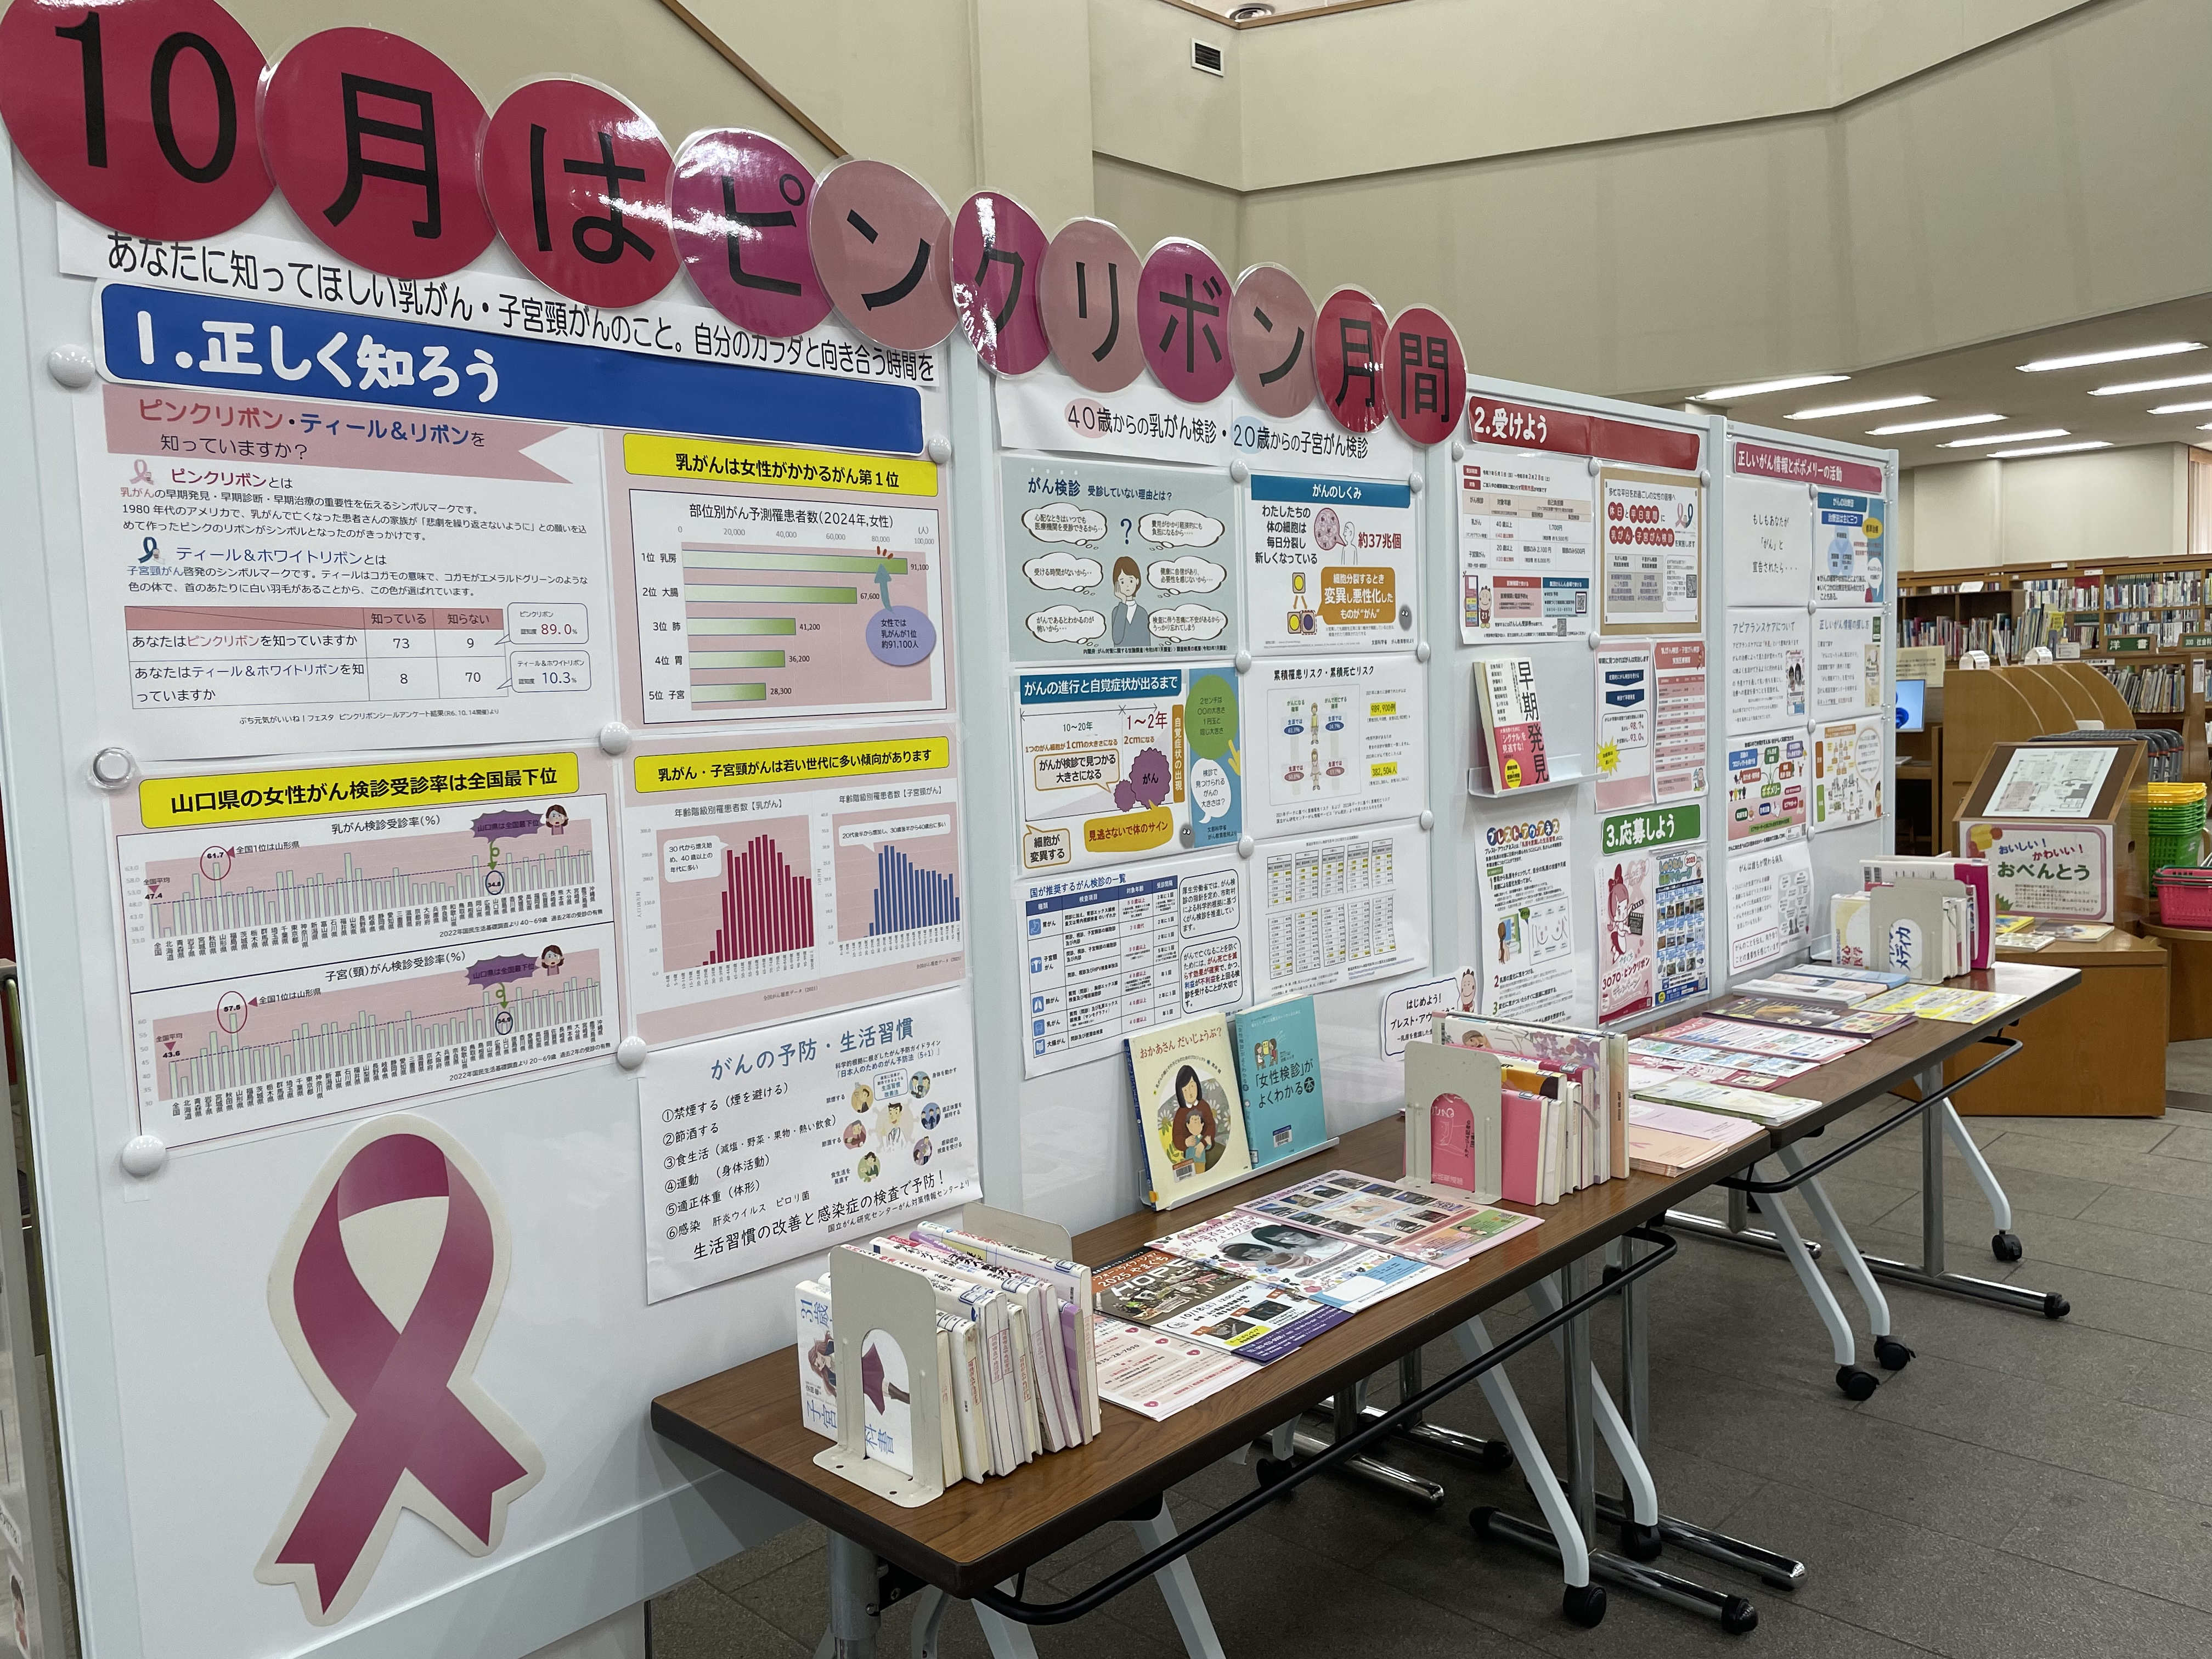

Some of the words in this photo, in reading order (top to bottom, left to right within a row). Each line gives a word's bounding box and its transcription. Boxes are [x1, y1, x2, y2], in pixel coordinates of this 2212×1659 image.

[137, 310, 499, 403] 1.正しく知ろう
[1474, 405, 1548, 443] 2.受けよう
[1067, 404, 1370, 460] 40歳からの乳がん検診・20歳からの子宮がん検診
[161, 433, 308, 460] 知っていますか?
[675, 453, 900, 488] 乳がんは女性がかかるがん第1位
[172, 467, 294, 490] ピンクリボンとは
[1028, 477, 1081, 497] がん検診
[1087, 485, 1172, 501] 受診していない理由とは?
[1312, 483, 1362, 500] がんのしくみ
[1034, 513, 1087, 524] 心配なときはいつでも
[1262, 505, 1311, 518] わたしたちの
[1266, 521, 1307, 534] 体の細胞は
[1753, 514, 1790, 528] もしもあなたが
[1266, 537, 1306, 549] 毎日分裂し
[1358, 532, 1402, 549] 約37兆個
[1760, 535, 1784, 551] 「がん」と
[176, 547, 387, 567] ティール&ホワイトリボンとは
[641, 552, 655, 563] 1位
[660, 552, 677, 564] 乳房
[1255, 552, 1318, 565] 新しくなっている
[910, 563, 929, 572] 91,100
[1333, 573, 1385, 584] 細胞分裂するとき
[642, 588, 657, 598] 2位
[662, 587, 679, 598] 大腸
[860, 592, 880, 601] 67,600
[1324, 586, 1393, 605] 変異し悪性化した
[371, 612, 427, 625] 知っている
[447, 612, 489, 625] 知らない
[881, 618, 907, 628] 女性では
[1036, 616, 1094, 625] がんであるとわかるのが
[541, 623, 578, 636] 89.0%
[652, 621, 668, 632] 3位
[672, 621, 681, 633] 肺
[799, 623, 821, 632] 41,200
[881, 629, 918, 640] 乳がんが1位
[1153, 623, 1196, 632] うっかり忘れてしまう
[1732, 621, 1796, 635] アピアランスケアについて
[132, 633, 358, 648] あなたはピンクリボンを知っていますか
[392, 637, 410, 649] 73
[467, 637, 475, 648] 9
[881, 640, 919, 650] 約91,100人
[654, 656, 670, 666] 4位
[674, 655, 683, 665] 胃
[789, 654, 810, 664] 36,200
[134, 662, 365, 680] あなたはティール&ホワイトリボンを知
[465, 672, 482, 683] 70
[541, 672, 578, 685] 10.3%
[400, 673, 409, 685] 8
[1024, 675, 1178, 696] がんの進行と自覚症状が出るまで
[136, 688, 216, 703] っていますか
[648, 690, 664, 701] 5位
[668, 690, 685, 701] 子宮
[770, 687, 792, 696] 28,300
[1199, 696, 1223, 705] 2センチは
[1518, 661, 1549, 784] 早期発見
[1199, 727, 1224, 736] 同じ大きさ
[1123, 735, 1155, 745] 2cmになる
[1174, 716, 1183, 791] 自覚症状の出現
[658, 748, 933, 782] 乳がん・子宮頸がんは若い世代に多い傾向があります
[1039, 754, 1116, 771] がんが検診で見つかる
[1056, 769, 1102, 783] 大きさになる
[1142, 773, 1159, 785] がん
[1203, 768, 1218, 777] 検診で
[171, 766, 557, 814] 山口県の女性がん検診受診率は全国最下位
[1195, 778, 1226, 788] 見つけられる
[1203, 789, 1218, 797] がんの
[1201, 798, 1226, 808] 大きさは?
[330, 814, 440, 835] 乳がん検診受診率(%)
[477, 819, 540, 833] 山口県は全国最下位
[1088, 821, 1169, 842] 見逃さないで体のサイン
[1606, 814, 1675, 848] 3.応募しよう
[235, 840, 301, 854] 全国1位は山形県
[1034, 833, 1060, 848] 細胞が
[1998, 838, 2047, 855] おいしい!
[1030, 848, 1065, 864] 変異する
[2032, 844, 2084, 861] かわいい!
[670, 863, 699, 874] 年代に多い
[1739, 854, 1784, 873] がんは誰もが関わる病気
[1996, 860, 2091, 881] おべんとう
[143, 877, 171, 885] 全国平均
[1029, 873, 1127, 898] 国が推奨するがん検診の一覧
[1182, 878, 1235, 895] 厚生労働省では、がん検
[144, 892, 163, 900] 47.4
[1182, 887, 1236, 905] 診の指針を定め、市町村
[1183, 896, 1237, 914] による科学的根拠に基づ
[1183, 907, 1234, 923] くがん検診を推進してい
[1183, 942, 1238, 960] がんで亡くなることを防ぐ
[1183, 952, 1238, 969] ためには、がん死亡を減
[472, 962, 535, 979] 山口県は全国最下位
[1184, 969, 1240, 990] 利益が不利益を上回る検
[1184, 979, 1238, 998] 診を受けることが大切で
[258, 988, 321, 1005] 全国1位は山形県
[1406, 992, 1442, 1010] はじめよう!
[223, 1004, 241, 1013] 57.5
[155, 1032, 183, 1043] 全国平均
[1140, 1040, 1176, 1059] おかあさん
[1177, 1026, 1222, 1048] だいじょうぶ?
[162, 1050, 180, 1059] 43.6
[710, 1016, 914, 1081] がんの予防・生活習慣
[835, 1040, 941, 1070] 科学的根拠に根ざしたがん予防ガイドライン
[1255, 1058, 1314, 1089] 「女性検診」が
[662, 1122, 719, 1147] ②節酒する
[664, 1173, 699, 1193] ④運動
[827, 1179, 970, 1233] 国立がん研究センターがん対策情報センターより
[666, 1220, 701, 1240] ⑥感染
[712, 1203, 767, 1228] 肝炎ウイルス
[776, 1190, 811, 1209] ピロリ菌
[693, 1170, 944, 1261] 生活習慣の改善と感染症の検査で予防!
[1097, 1272, 1132, 1288] 2025
[1129, 1256, 1170, 1273] やまぐち
[1110, 1257, 1196, 1297] HOPE
